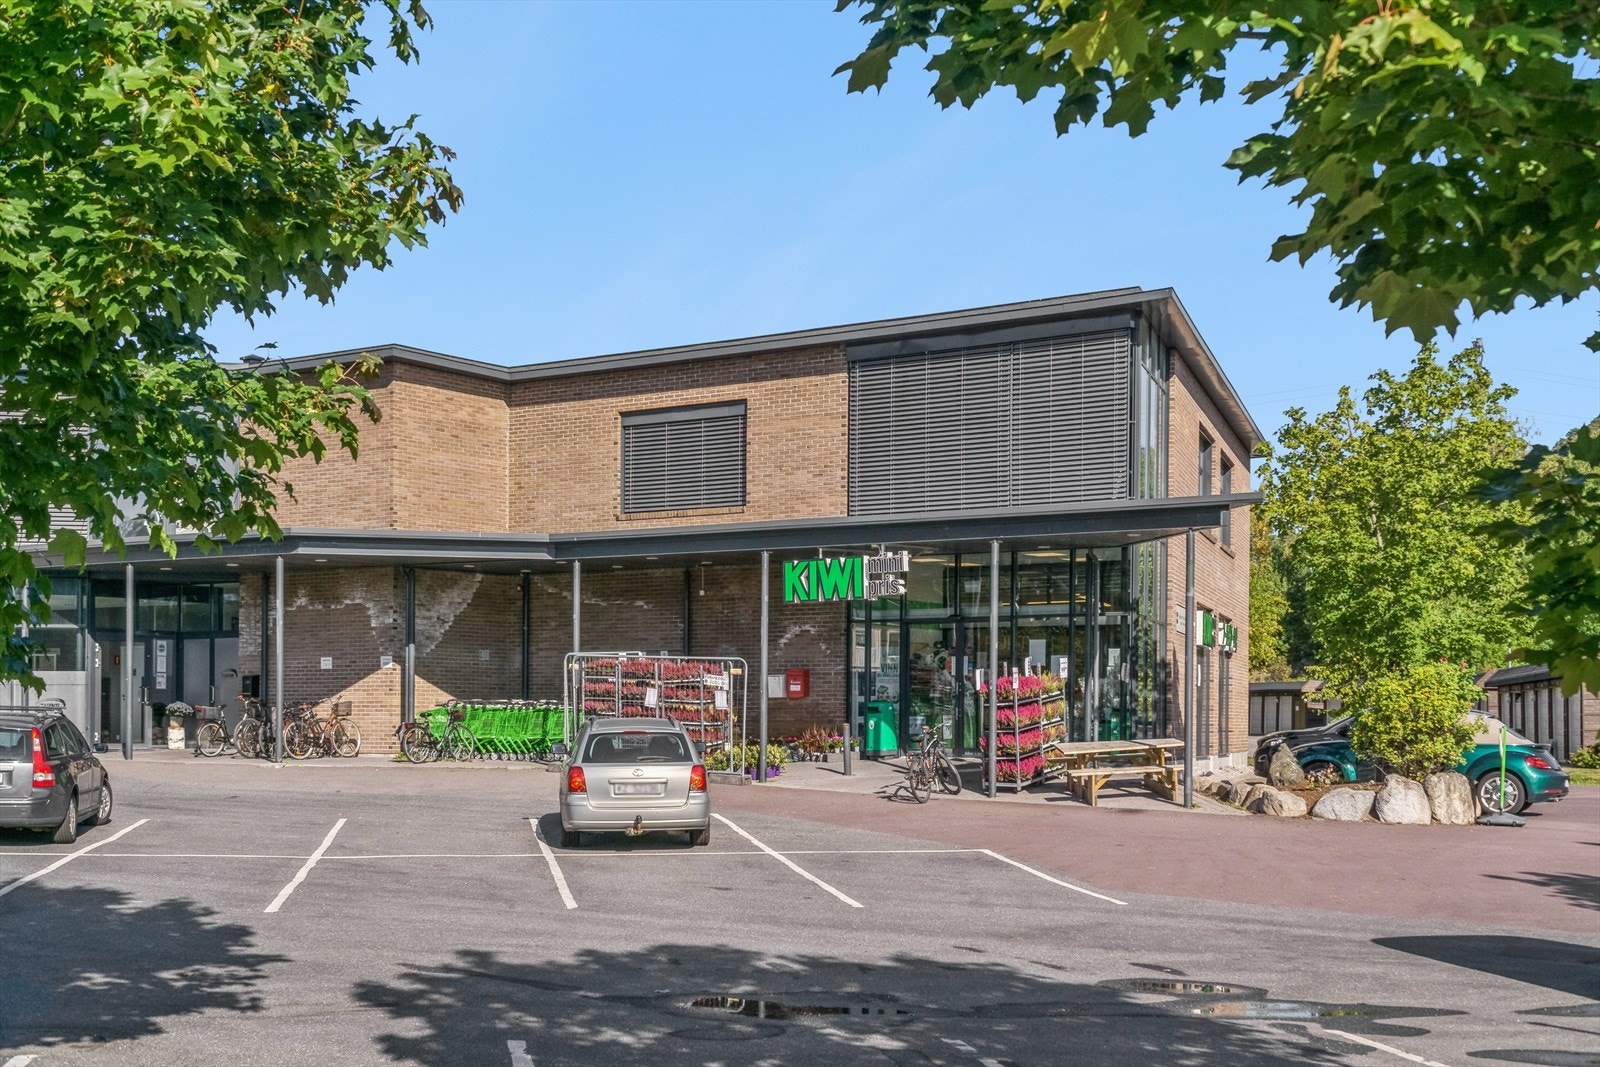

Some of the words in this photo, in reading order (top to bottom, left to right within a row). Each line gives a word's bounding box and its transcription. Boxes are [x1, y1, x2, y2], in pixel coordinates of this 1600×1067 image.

[868, 551, 905, 573] mini
[784, 557, 863, 602] KIWI
[868, 574, 900, 600] pris
